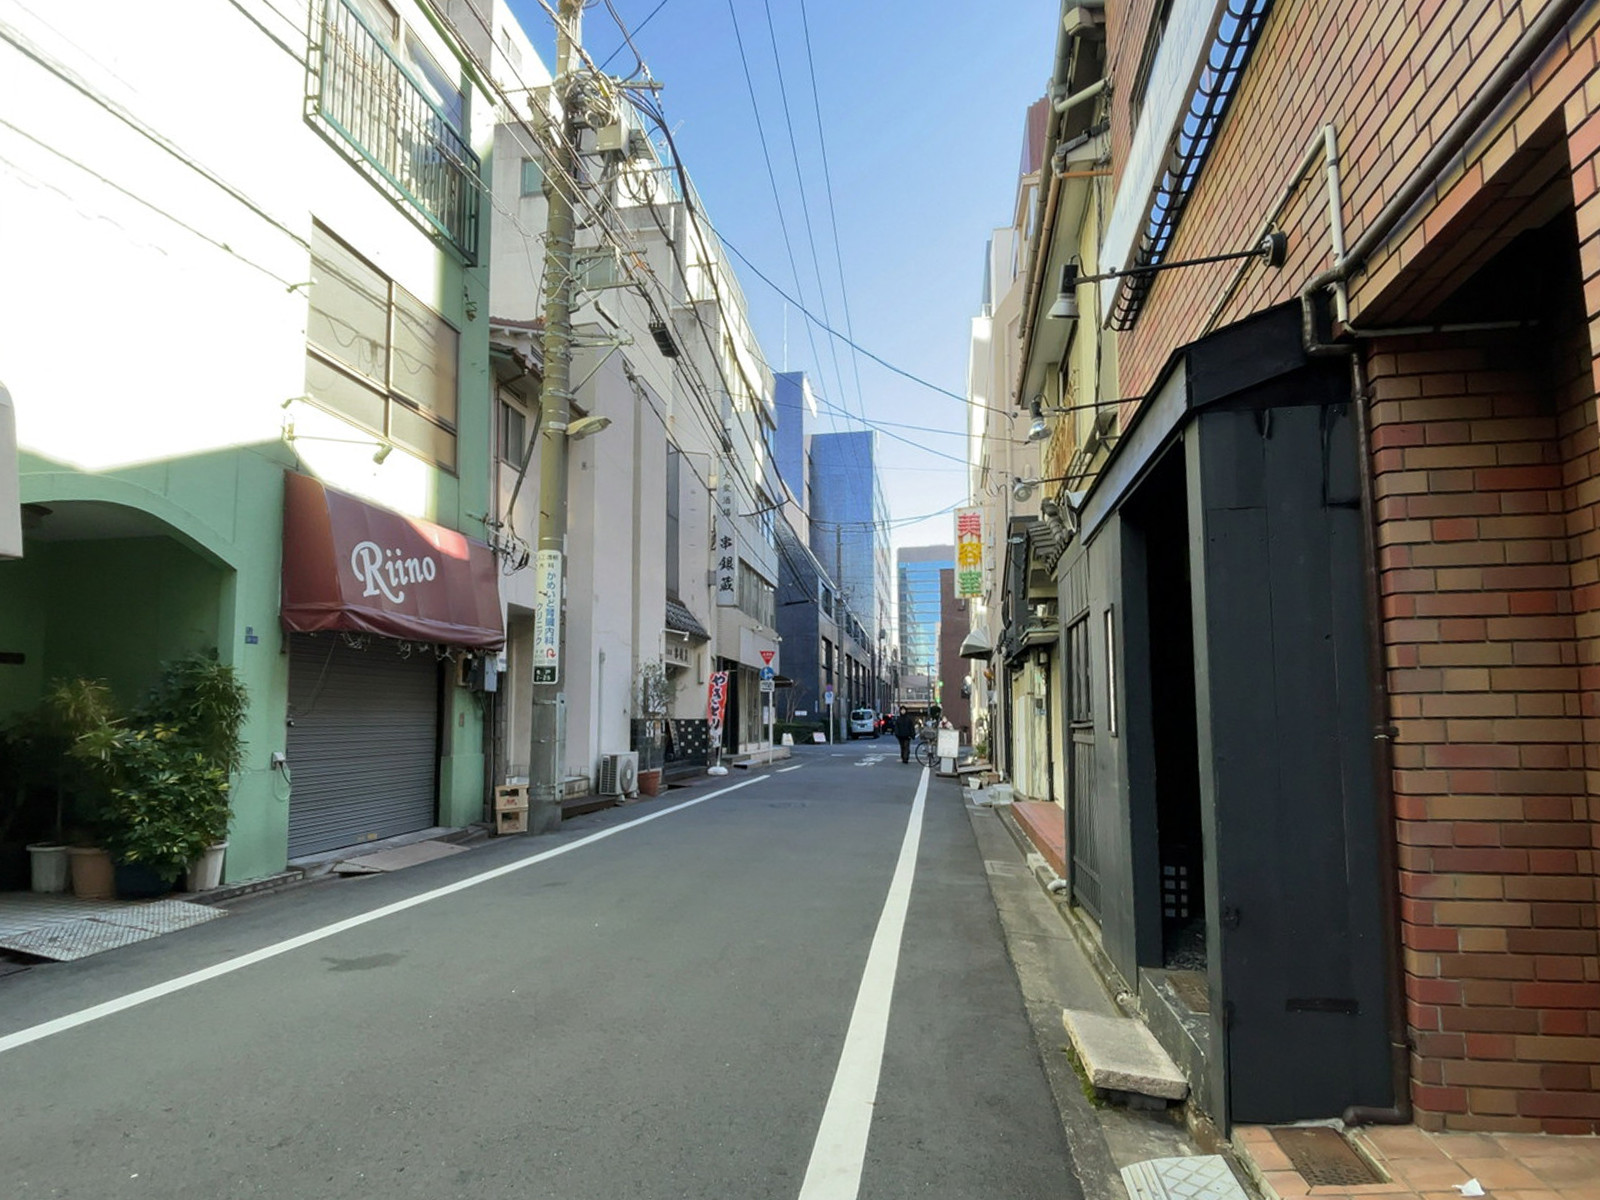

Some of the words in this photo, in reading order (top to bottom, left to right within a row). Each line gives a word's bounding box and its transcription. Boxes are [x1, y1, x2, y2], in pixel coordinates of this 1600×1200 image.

[351, 541, 436, 604] Riino
[719, 535, 734, 592] 串銀蔵
[710, 675, 726, 730] やきとり
